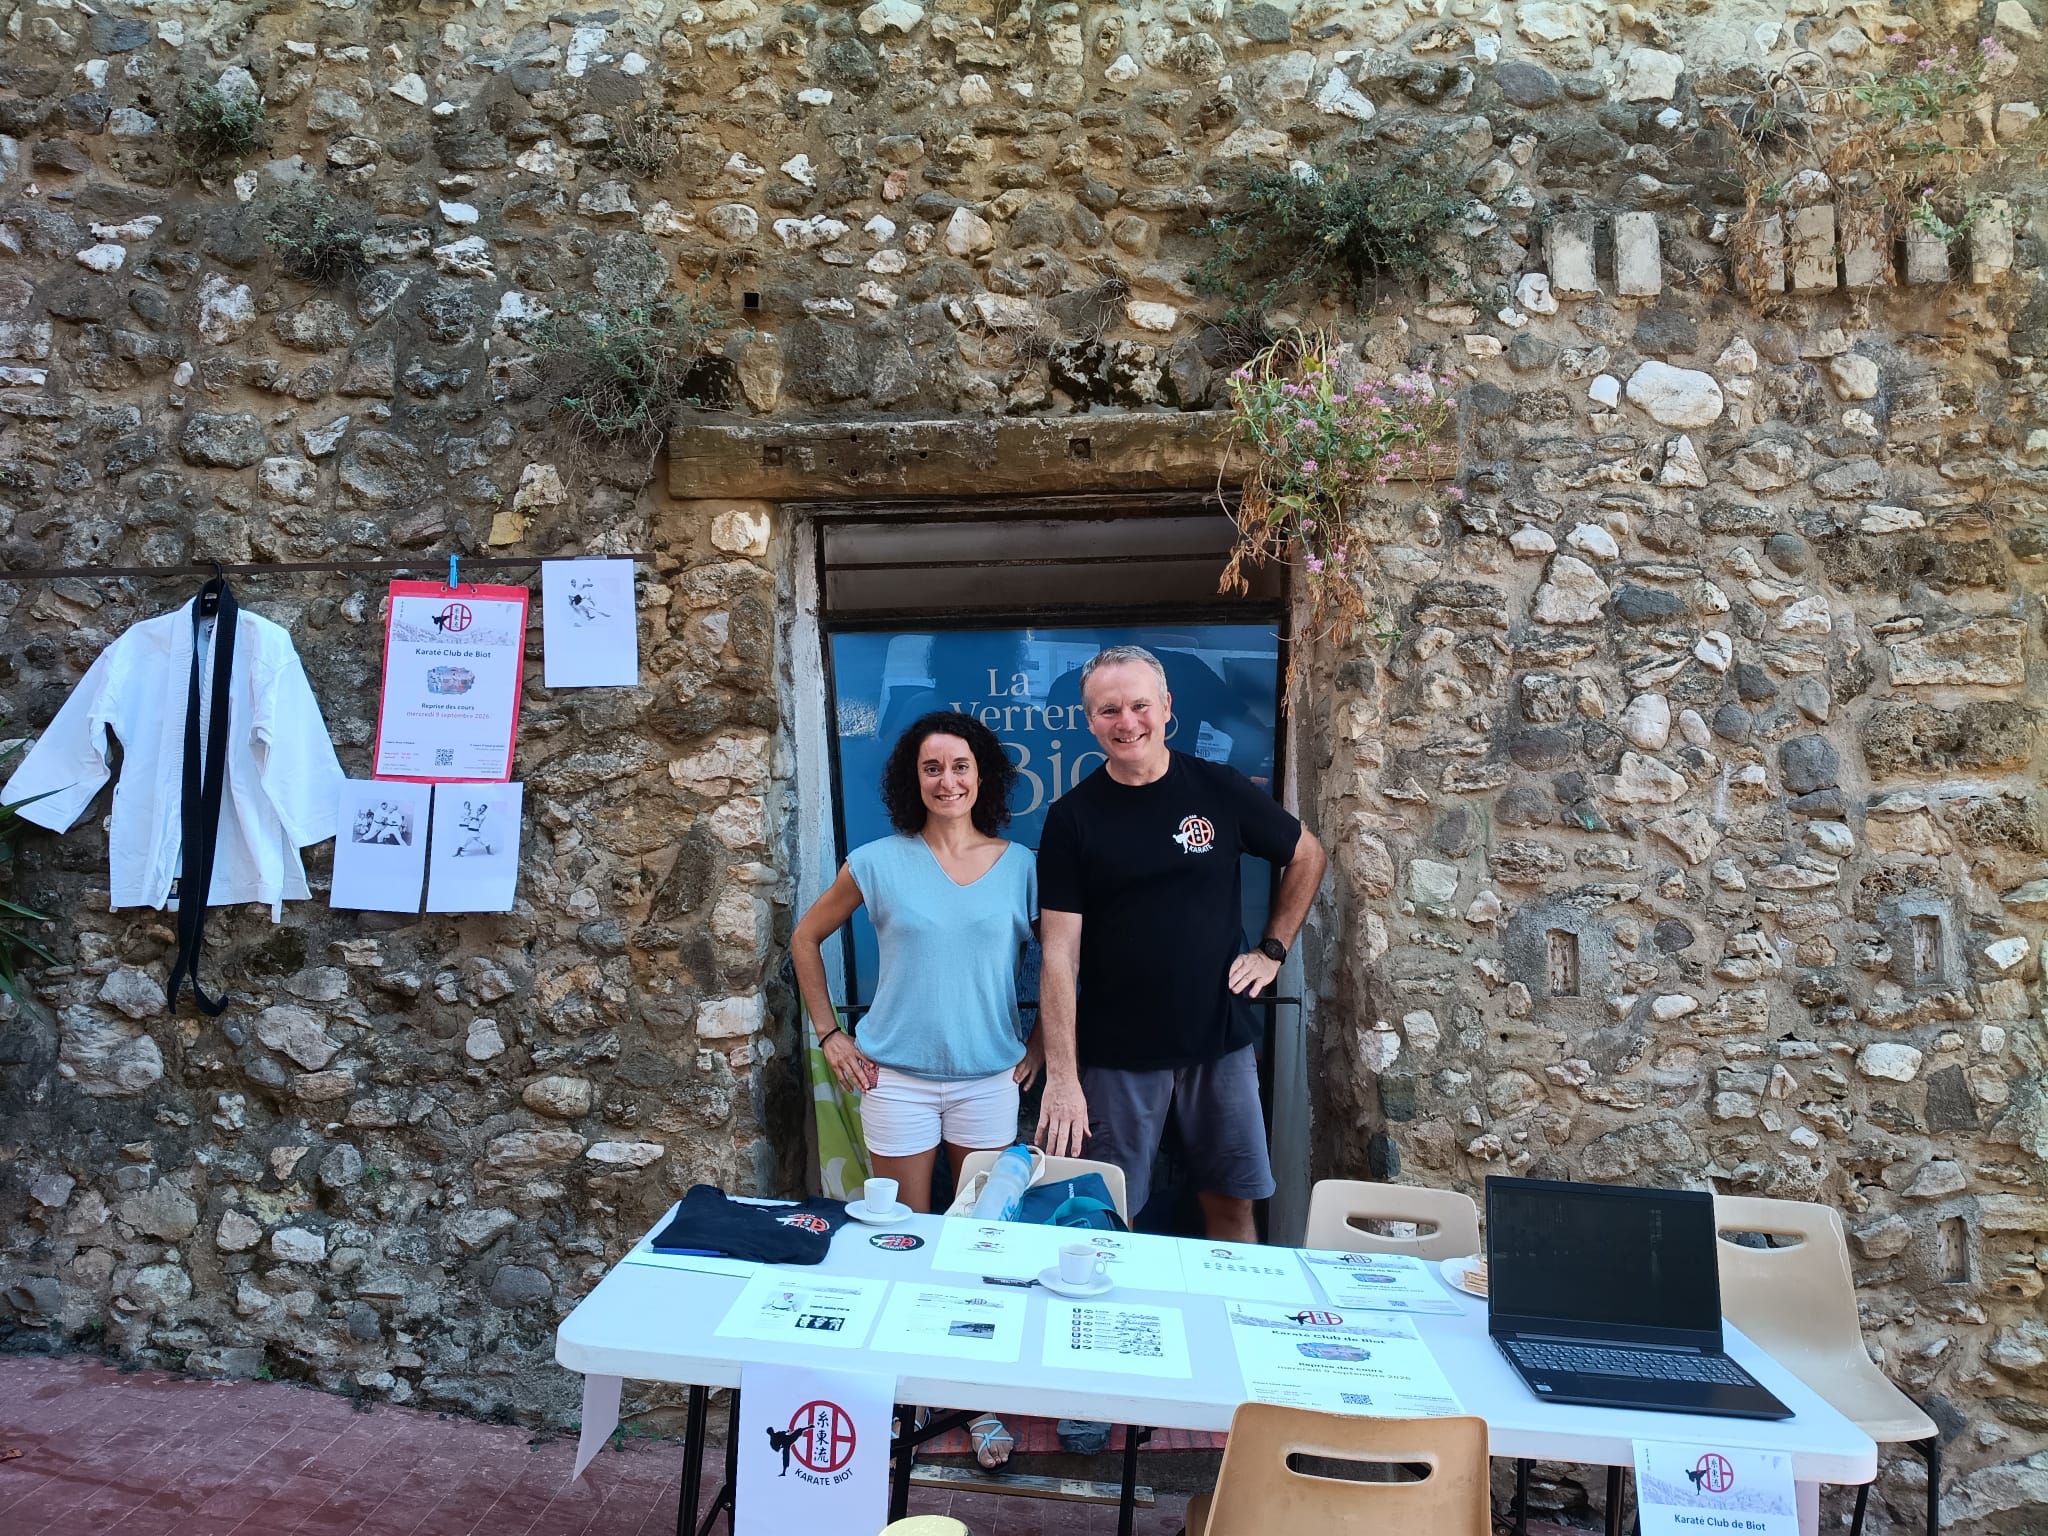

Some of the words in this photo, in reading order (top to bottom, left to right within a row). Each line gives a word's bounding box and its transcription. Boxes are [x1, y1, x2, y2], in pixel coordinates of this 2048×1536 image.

[415, 648, 442, 656] Karaté
[443, 649, 461, 657] Club
[475, 650, 491, 658] Biot
[986, 668, 1030, 697] La
[1188, 842, 1214, 854] KARATE
[1313, 1333, 1342, 1341] Club
[813, 1410, 830, 1463] 糸東流
[794, 1467, 831, 1486] KARATE
[833, 1467, 854, 1485] BIOT
[1673, 1513, 1705, 1525] Karaté
[1706, 1516, 1730, 1528] Club
[1731, 1519, 1744, 1529] de
[1746, 1520, 1767, 1531] Biot
